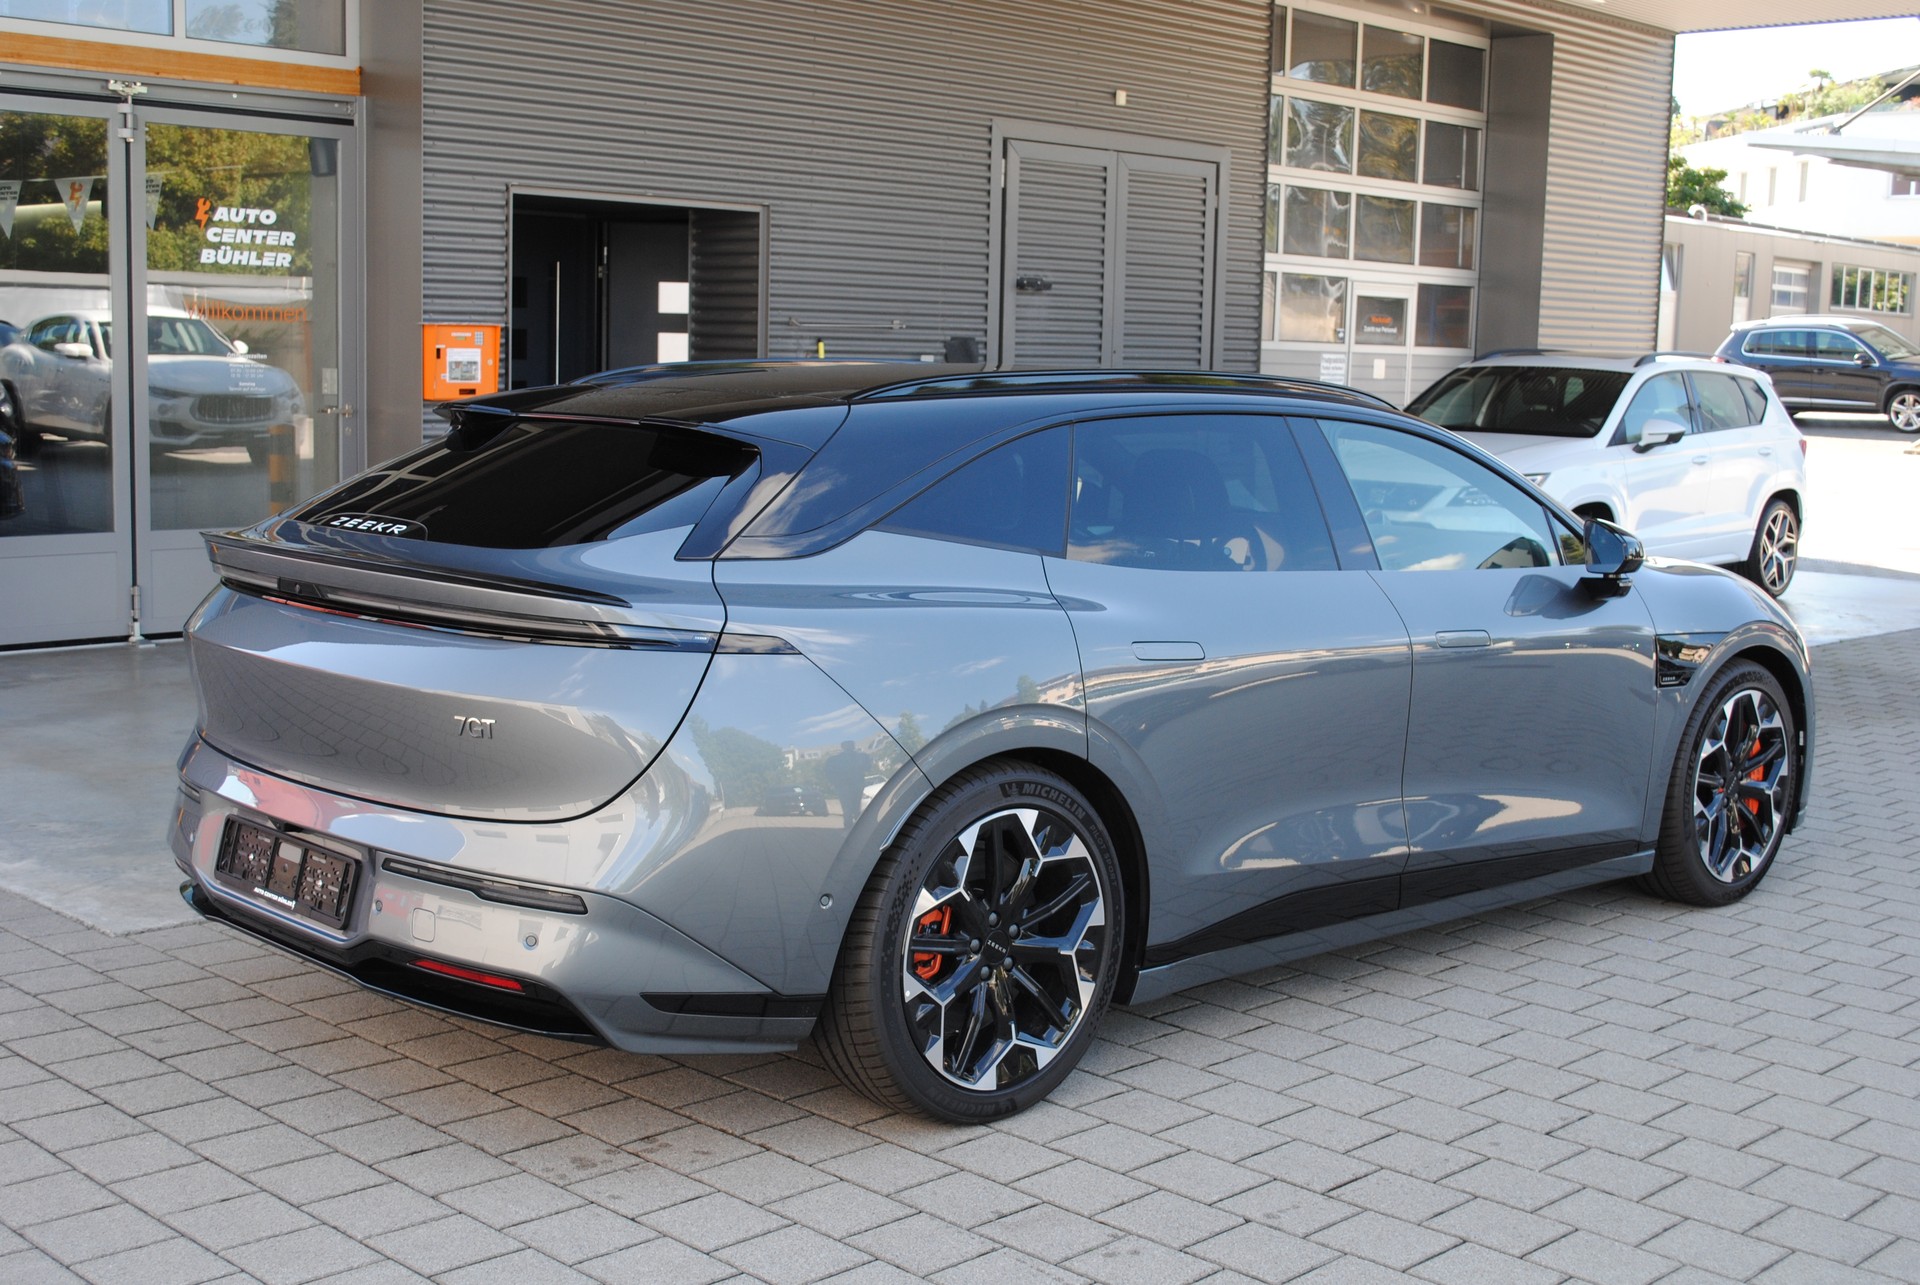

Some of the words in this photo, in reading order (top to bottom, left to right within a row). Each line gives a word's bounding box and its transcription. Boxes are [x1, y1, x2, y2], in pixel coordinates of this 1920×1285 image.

[212, 206, 277, 225] AUTO
[206, 227, 296, 246] CENTER
[200, 245, 292, 267] BÜHLER
[185, 300, 307, 322] Willkommen
[330, 516, 408, 535] ZEEKR
[454, 715, 497, 739] 7GT
[1022, 783, 1088, 820] MICHELIN
